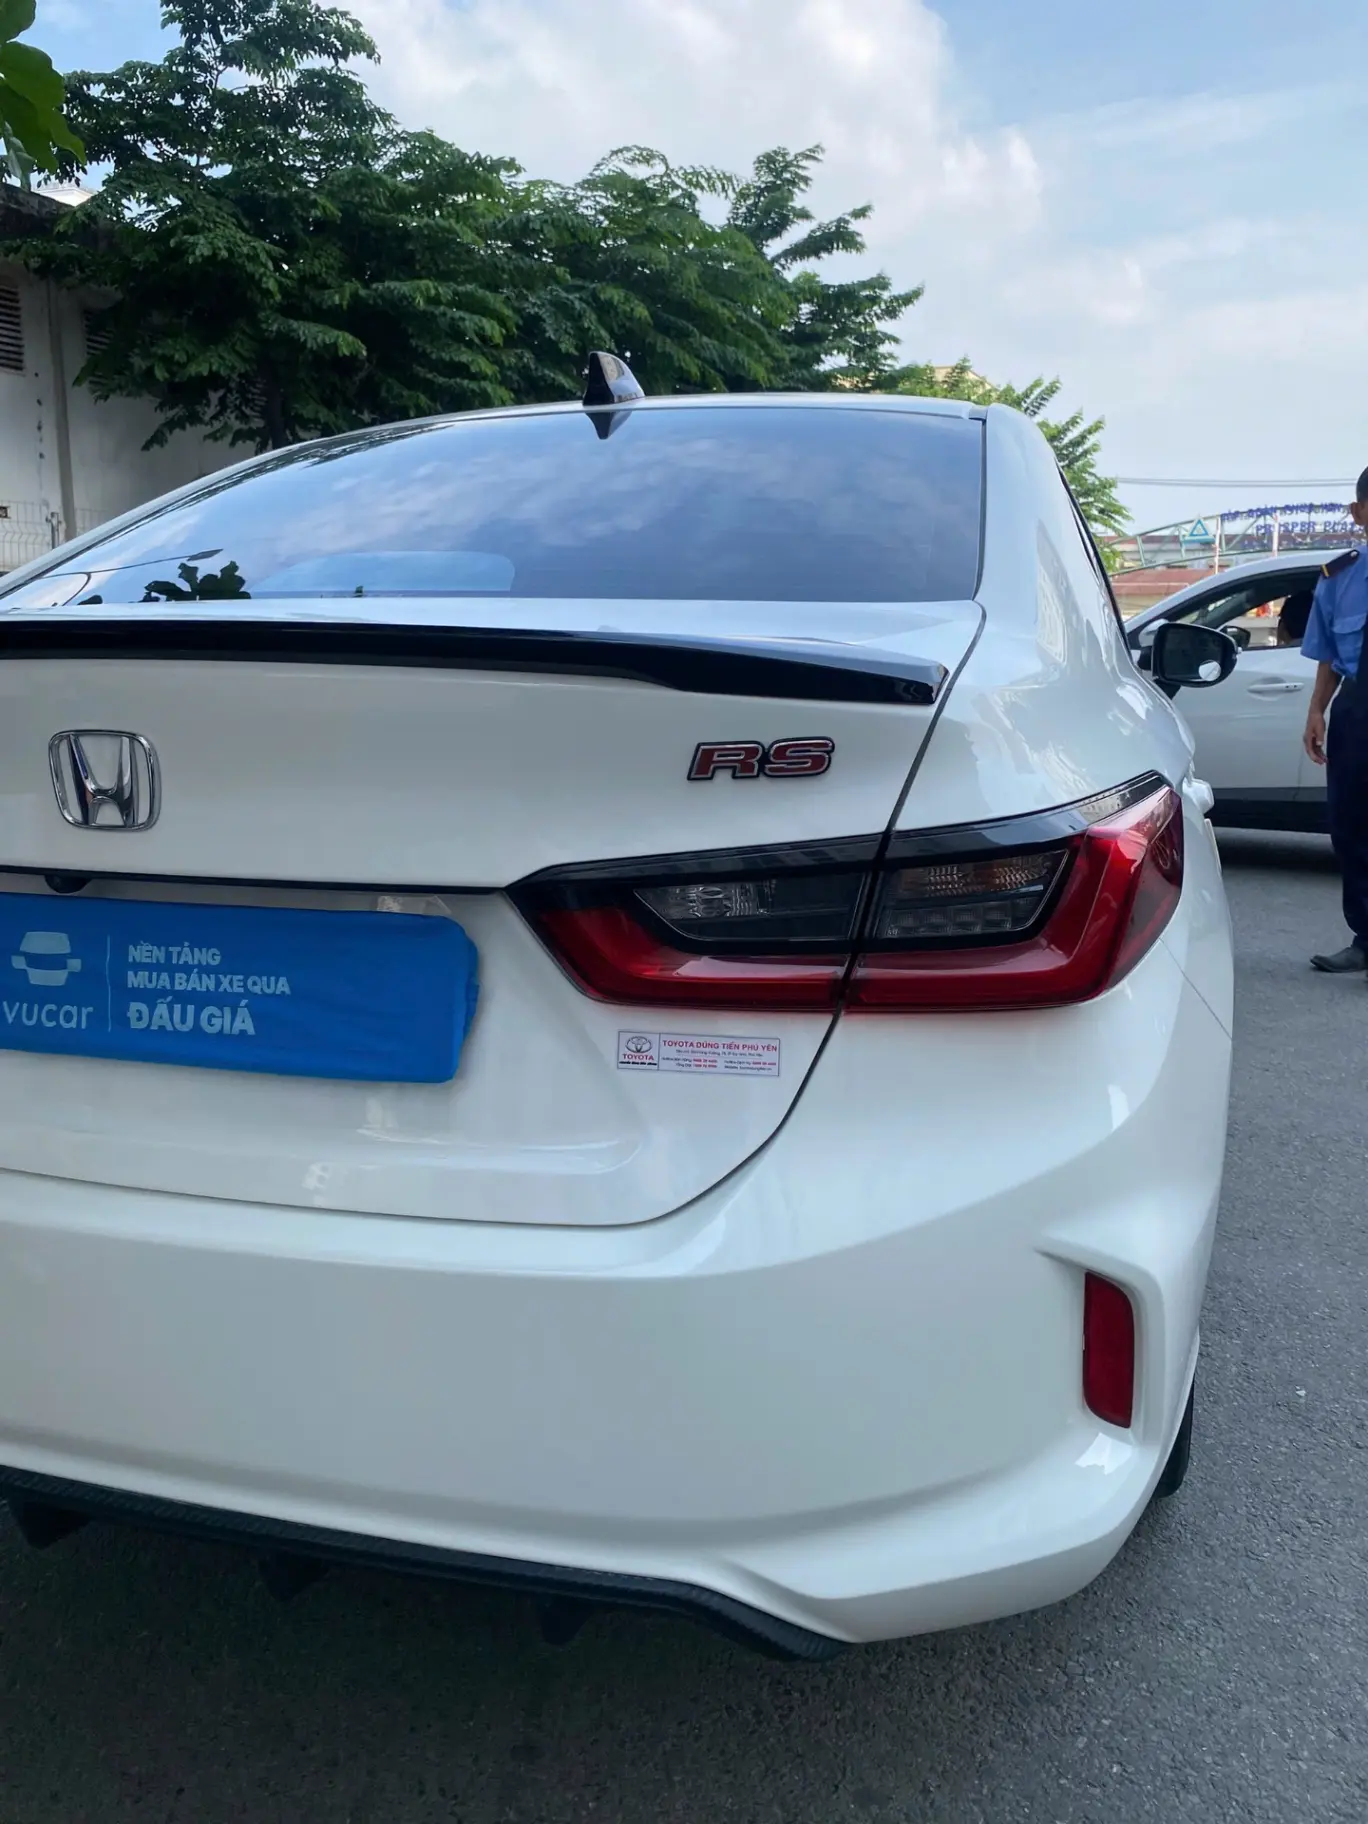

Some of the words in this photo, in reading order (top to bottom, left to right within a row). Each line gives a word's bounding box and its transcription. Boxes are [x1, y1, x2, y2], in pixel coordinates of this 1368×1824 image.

[687, 736, 836, 781] RS
[128, 940, 166, 964] NỀN
[169, 941, 221, 966] TẢNG
[127, 970, 171, 990] MUA
[174, 968, 216, 992] BÁN
[218, 974, 245, 993] XE
[247, 975, 292, 995] QUA
[2, 1001, 94, 1030] vucar
[127, 995, 195, 1032] ĐẤU
[200, 999, 256, 1036] GIÁ
[622, 1053, 655, 1061] TOYOTA
[662, 1040, 696, 1048] TOYOTA
